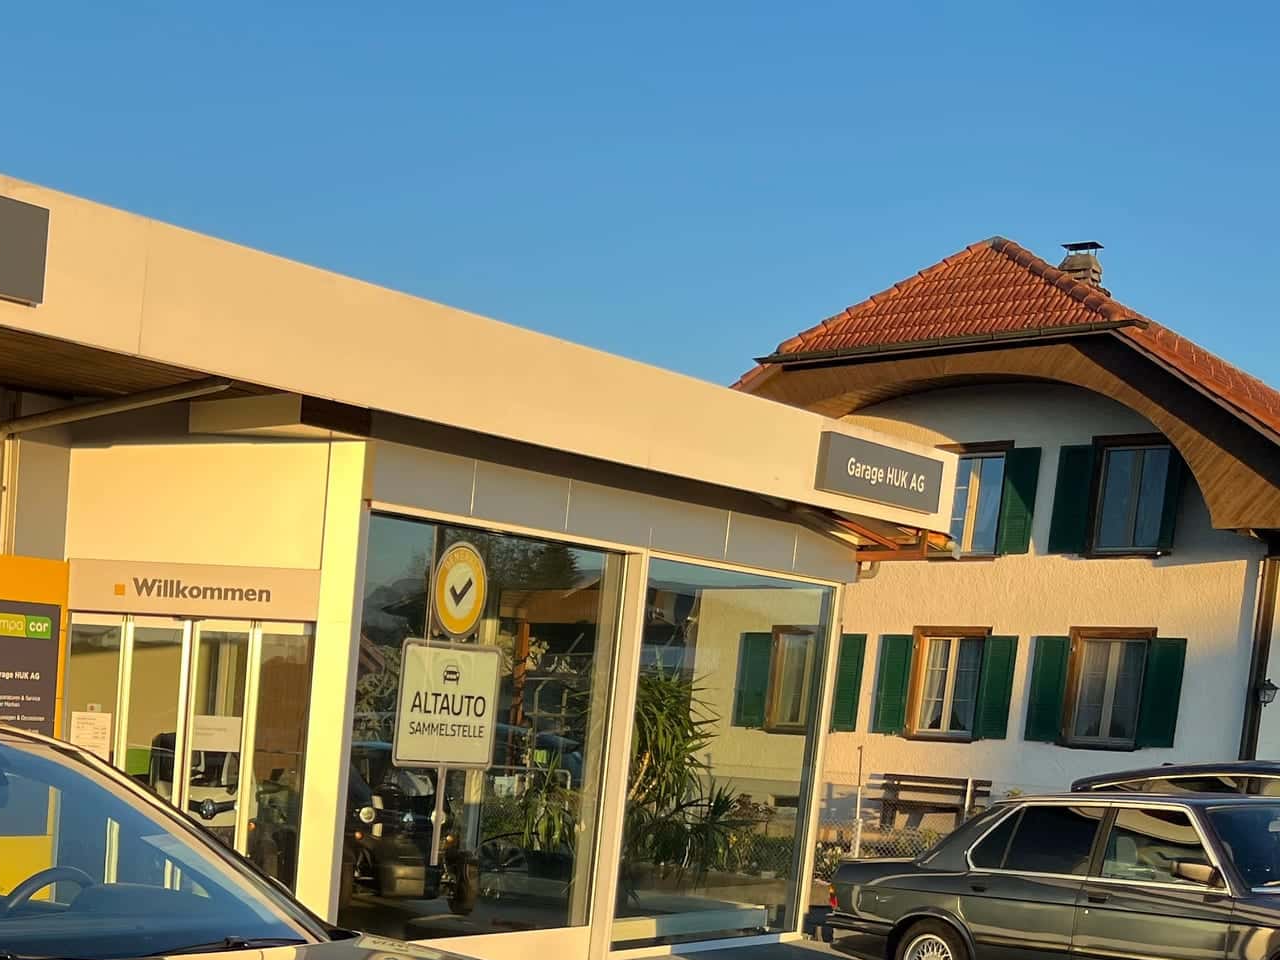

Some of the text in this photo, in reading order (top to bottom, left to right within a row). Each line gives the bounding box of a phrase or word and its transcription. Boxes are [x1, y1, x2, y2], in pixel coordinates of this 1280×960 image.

[847, 457, 926, 493] Garage HUK AG
[132, 576, 272, 603] Willkommen
[29, 621, 49, 633] car
[14, 671, 29, 680] HUK
[29, 672, 40, 681] AG
[410, 690, 486, 718] ALTAUTO
[408, 721, 485, 738] SAMMELSTELLE
